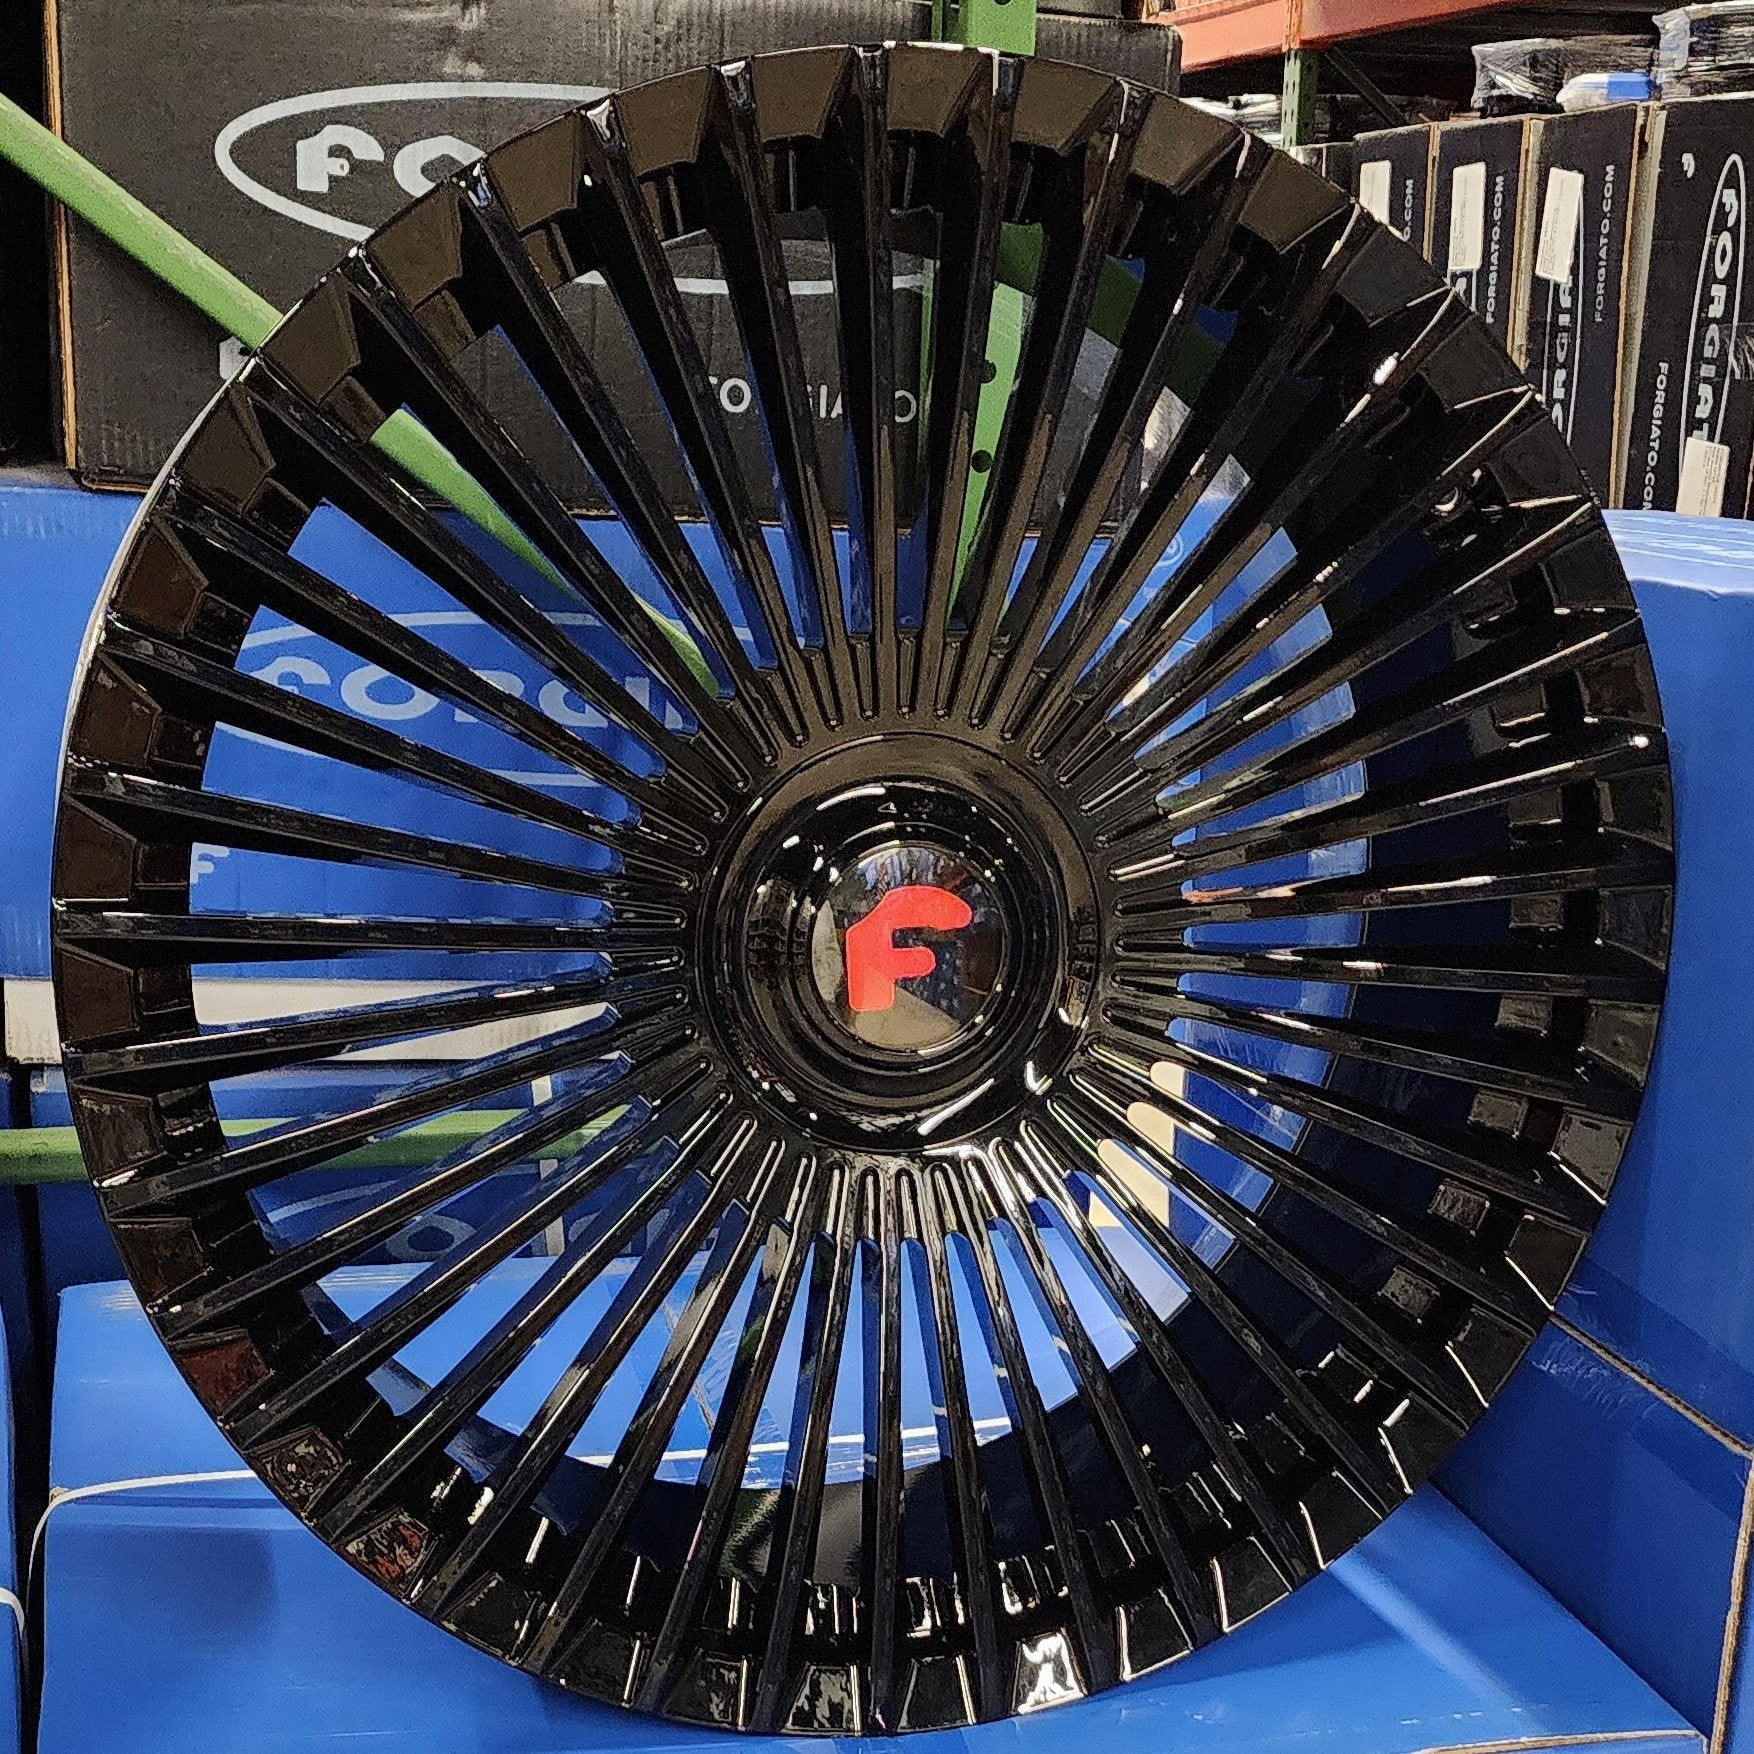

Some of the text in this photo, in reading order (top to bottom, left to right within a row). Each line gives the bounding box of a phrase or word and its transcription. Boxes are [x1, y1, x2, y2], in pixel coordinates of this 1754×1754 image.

[1485, 175, 1505, 324] FORGIATO.COM
[1594, 164, 1615, 322] FORGIATO.COM
[845, 885, 973, 1012] F
